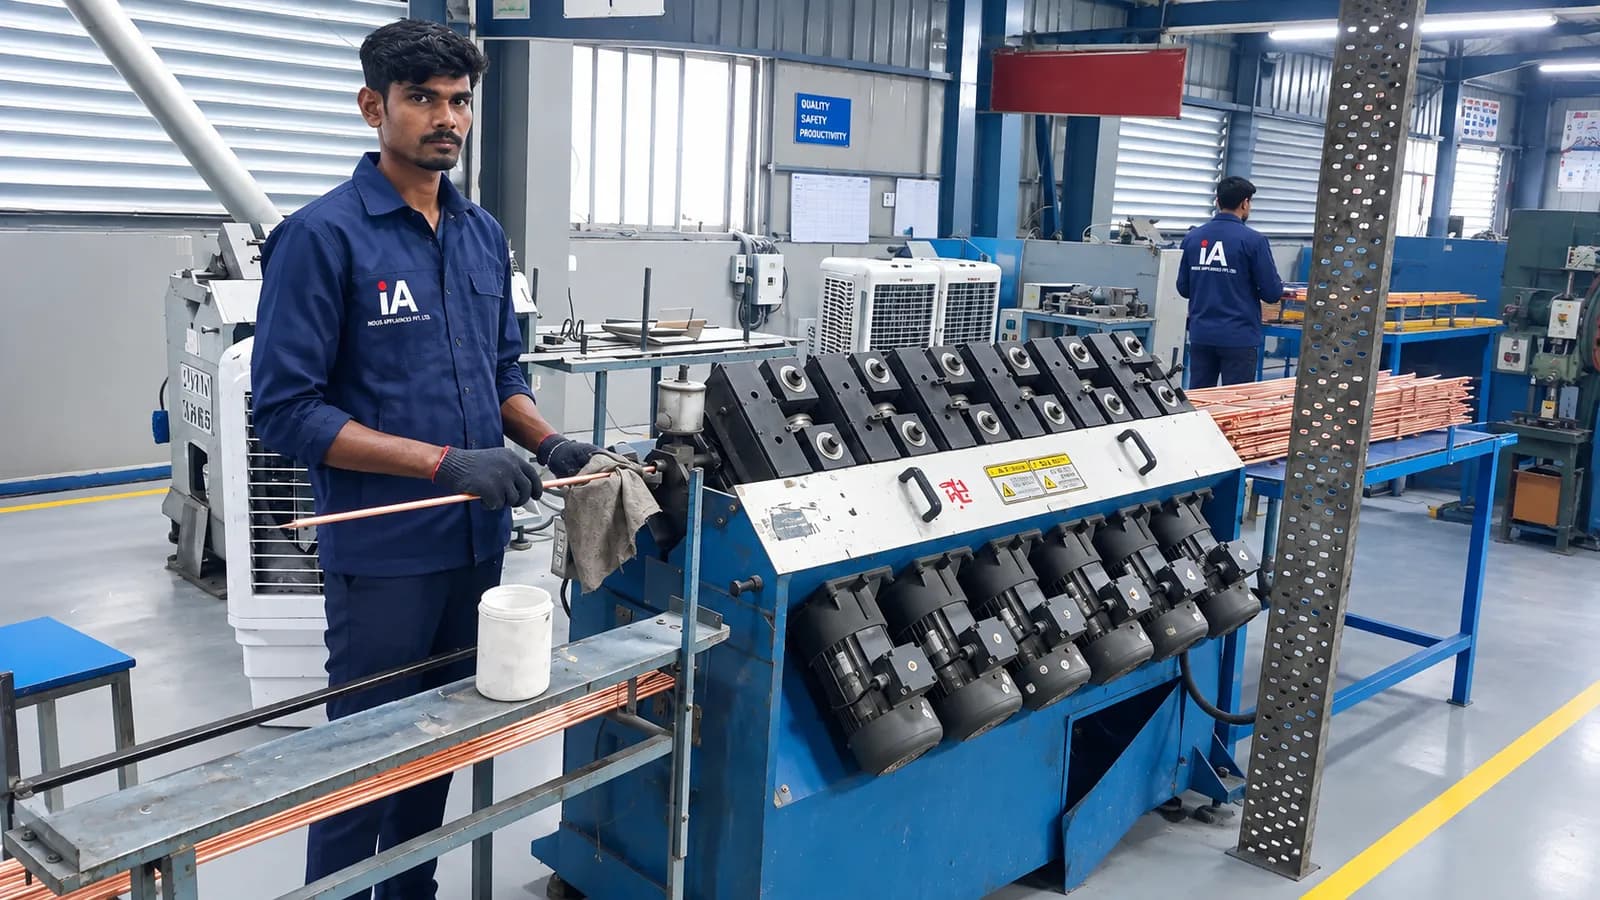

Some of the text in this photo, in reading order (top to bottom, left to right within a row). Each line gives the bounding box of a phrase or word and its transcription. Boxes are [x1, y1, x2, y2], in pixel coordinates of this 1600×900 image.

[801, 99, 830, 111] QUALITY
[801, 114, 827, 125] SAFETY
[800, 129, 847, 140] PRODUCTIVITY
